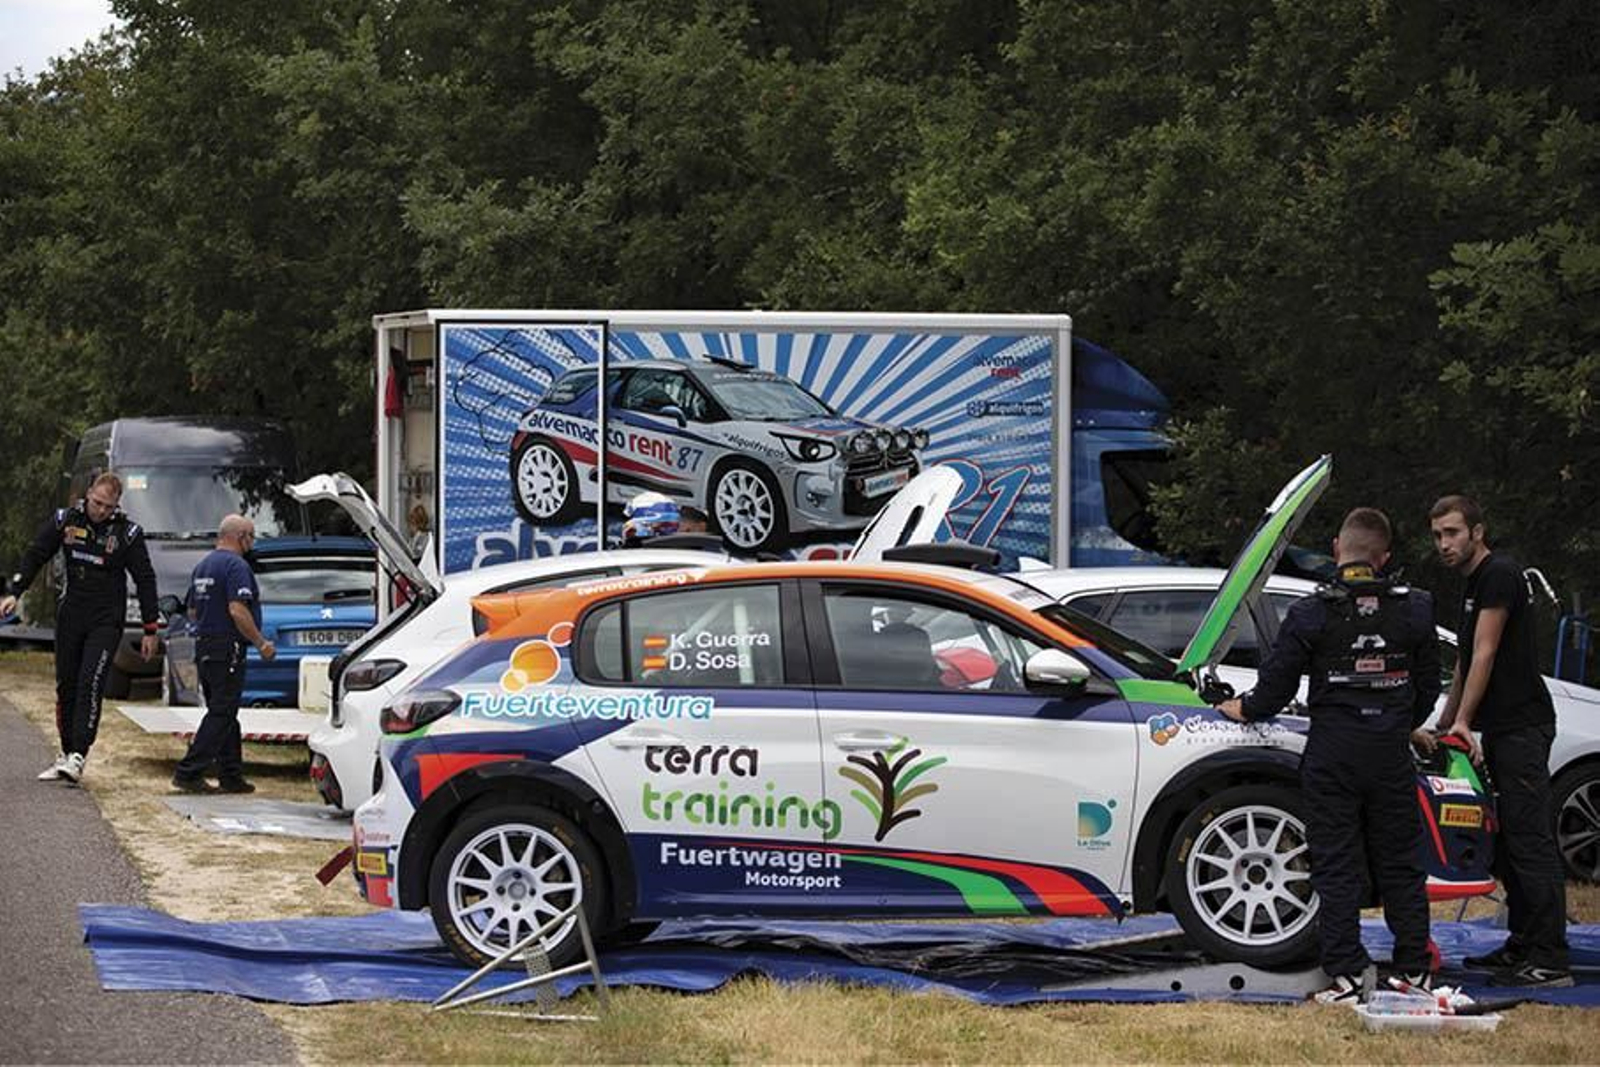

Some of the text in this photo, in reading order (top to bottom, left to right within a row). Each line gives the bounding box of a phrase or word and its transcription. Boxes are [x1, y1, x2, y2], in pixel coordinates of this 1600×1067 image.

[628, 433, 673, 466] rent
[676, 447, 703, 472] 87
[670, 631, 771, 649] K. Guerra
[669, 651, 751, 671] D. Sosa
[462, 690, 714, 720] Fuerteventura
[644, 745, 759, 777] terra
[642, 780, 842, 840] training
[660, 842, 842, 873] Fuertwagen
[745, 871, 842, 890] Motorsport
